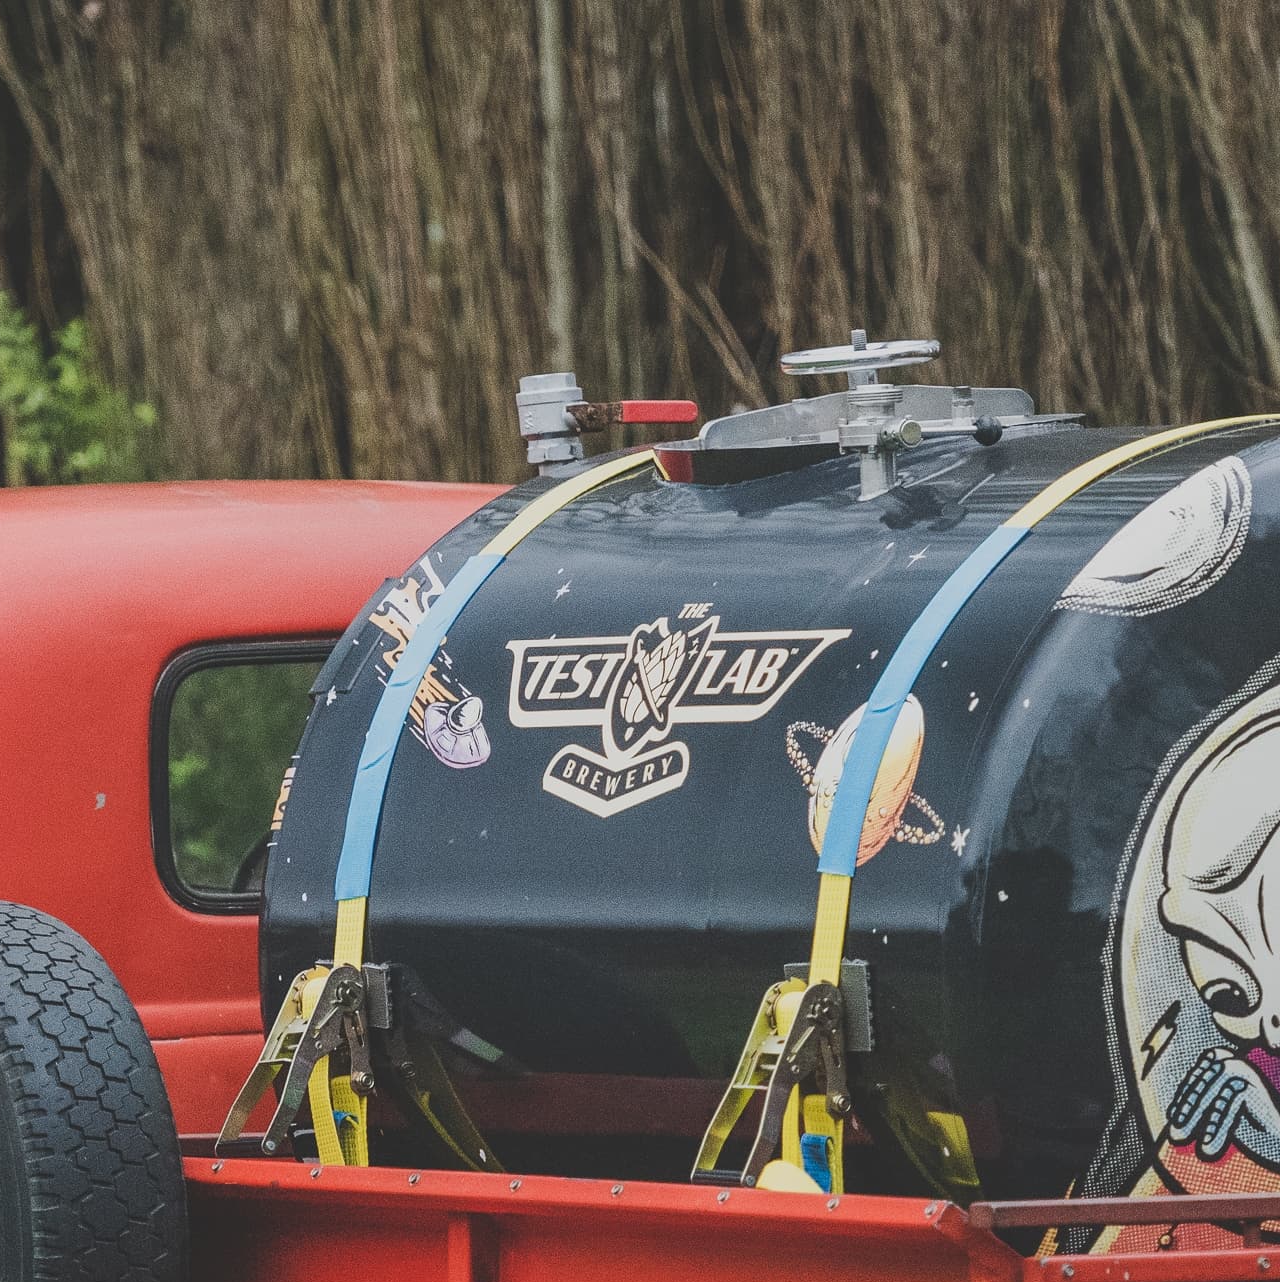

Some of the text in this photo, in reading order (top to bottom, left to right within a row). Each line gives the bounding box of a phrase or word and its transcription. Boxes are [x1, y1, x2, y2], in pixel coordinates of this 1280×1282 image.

[677, 602, 714, 619] THE
[525, 647, 791, 700] TEST LAB
[561, 754, 675, 795] BREWERY
